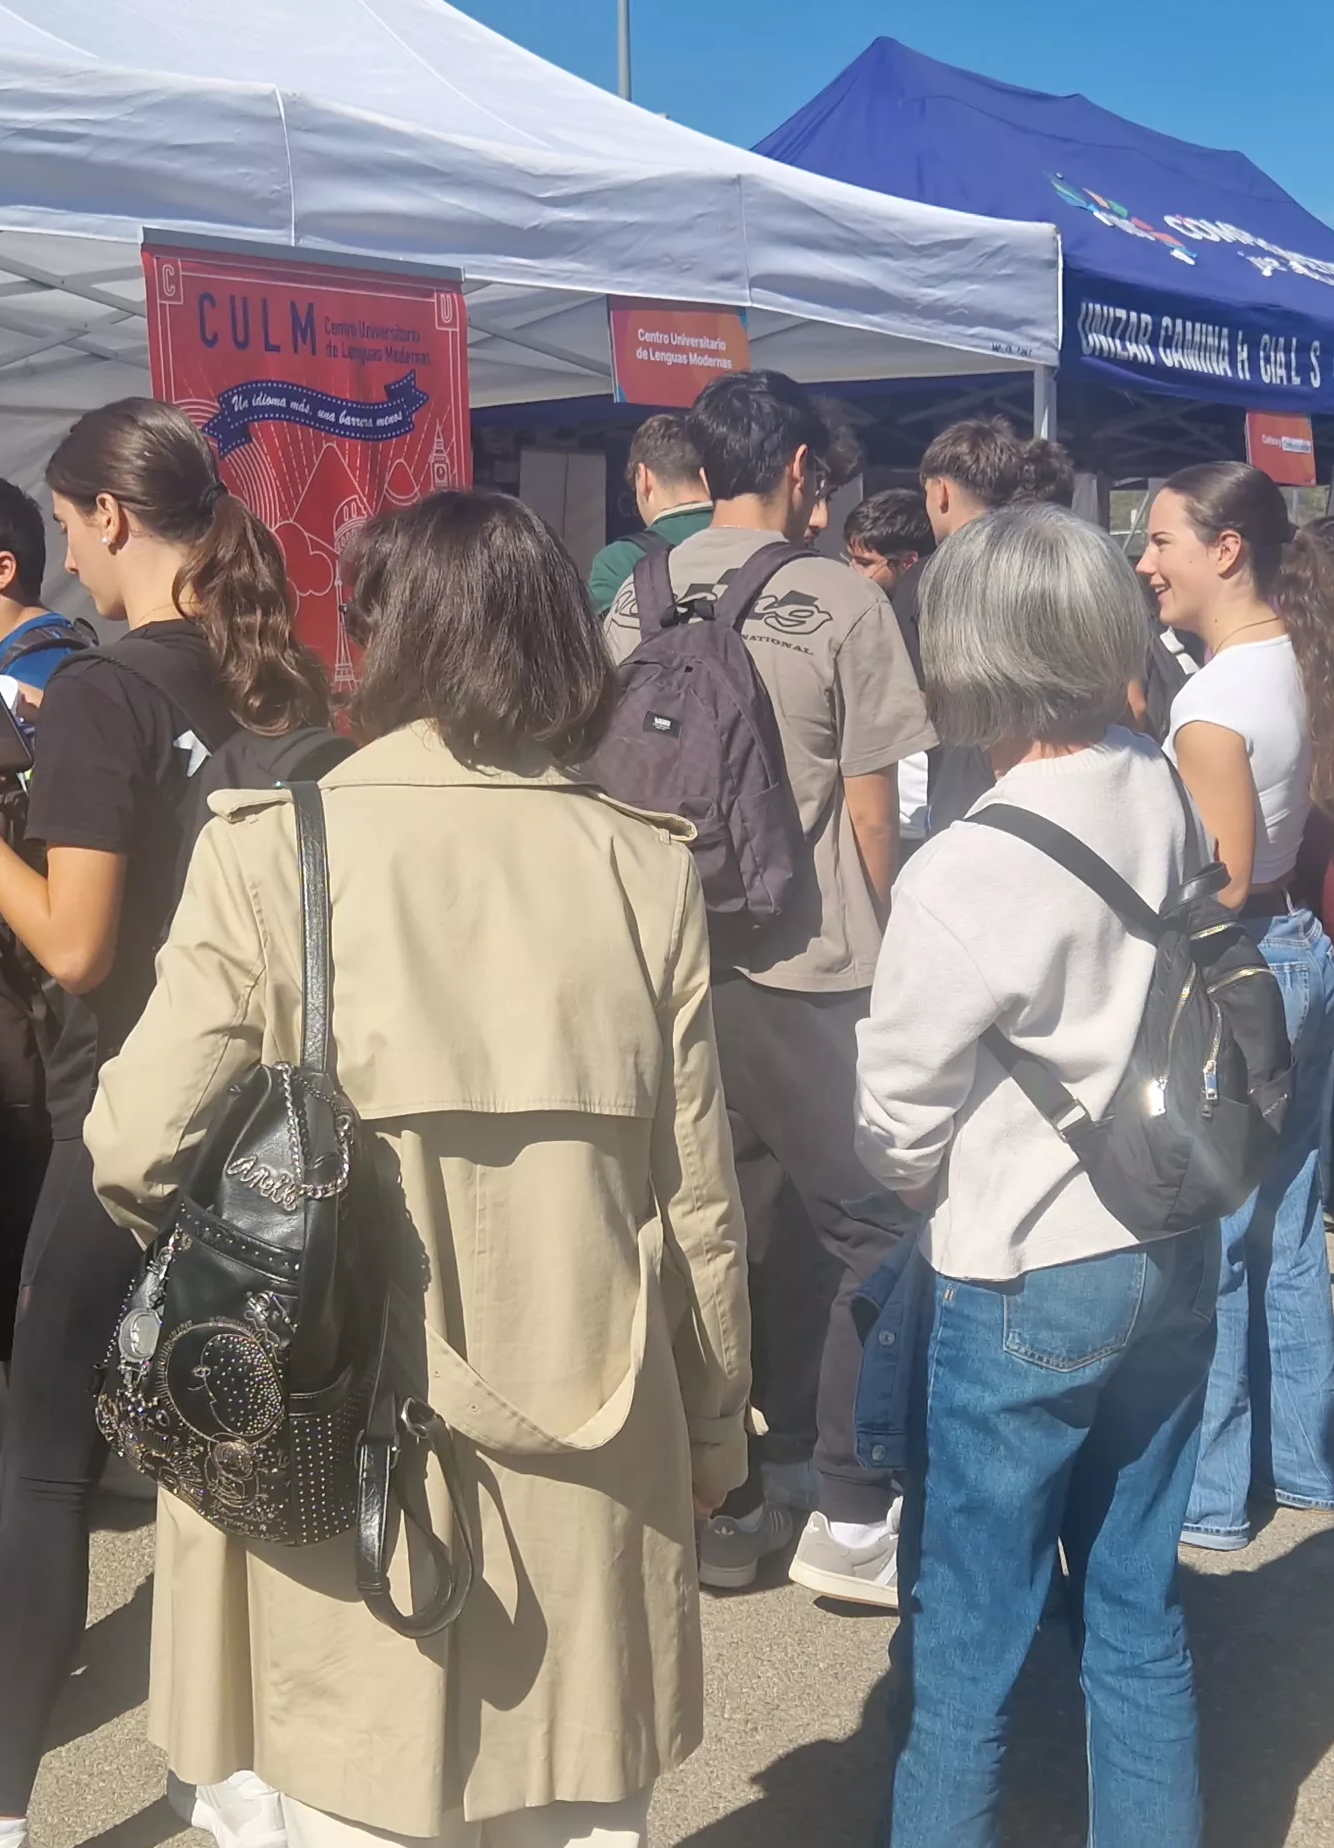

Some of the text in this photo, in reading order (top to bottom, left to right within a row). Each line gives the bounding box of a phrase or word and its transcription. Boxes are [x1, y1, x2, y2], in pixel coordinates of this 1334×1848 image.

[198, 292, 317, 357] CULM
[325, 317, 420, 343] Centro Universitario
[638, 328, 727, 352] Centro Universitario
[1077, 302, 1156, 366] UNIZAR
[1158, 316, 1233, 378] CAMINA
[1290, 337, 1321, 388] LS
[325, 343, 431, 366] de Lenguas Modernas
[636, 347, 733, 369] de Lenguas Modernas
[231, 390, 403, 428] Un idioma más, una barrera menos
[741, 633, 814, 656] NATIONAL
